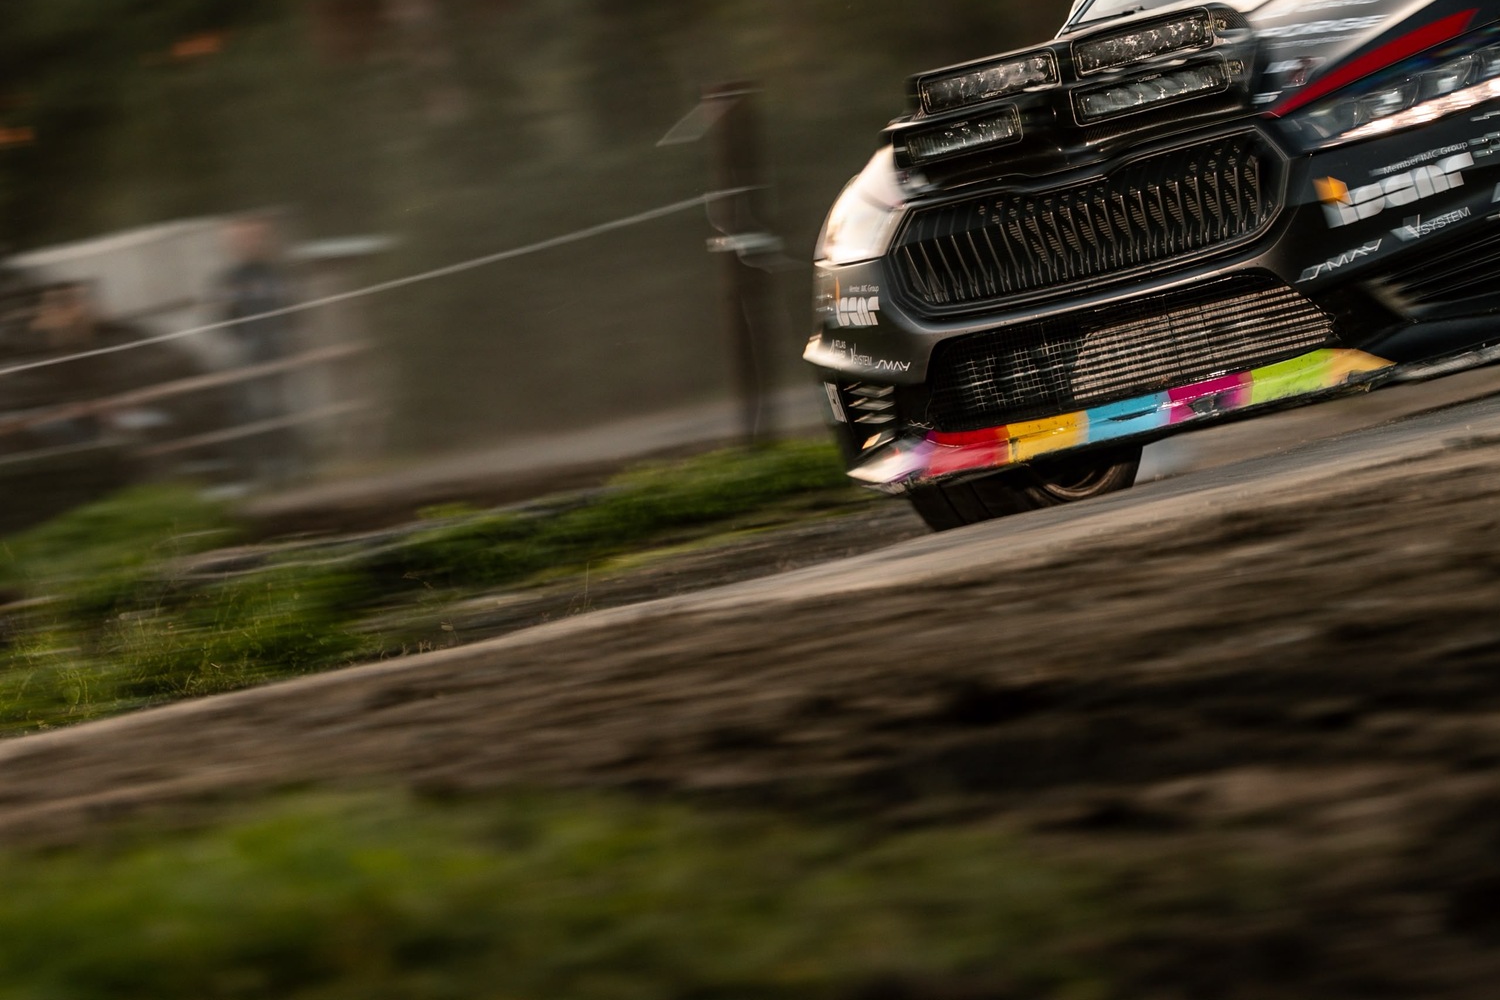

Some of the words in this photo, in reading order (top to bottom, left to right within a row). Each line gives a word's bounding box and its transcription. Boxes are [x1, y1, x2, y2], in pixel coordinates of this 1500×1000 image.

[1382, 157, 1420, 175] Member
[1419, 150, 1440, 164] IMC
[1439, 141, 1469, 156] Group
